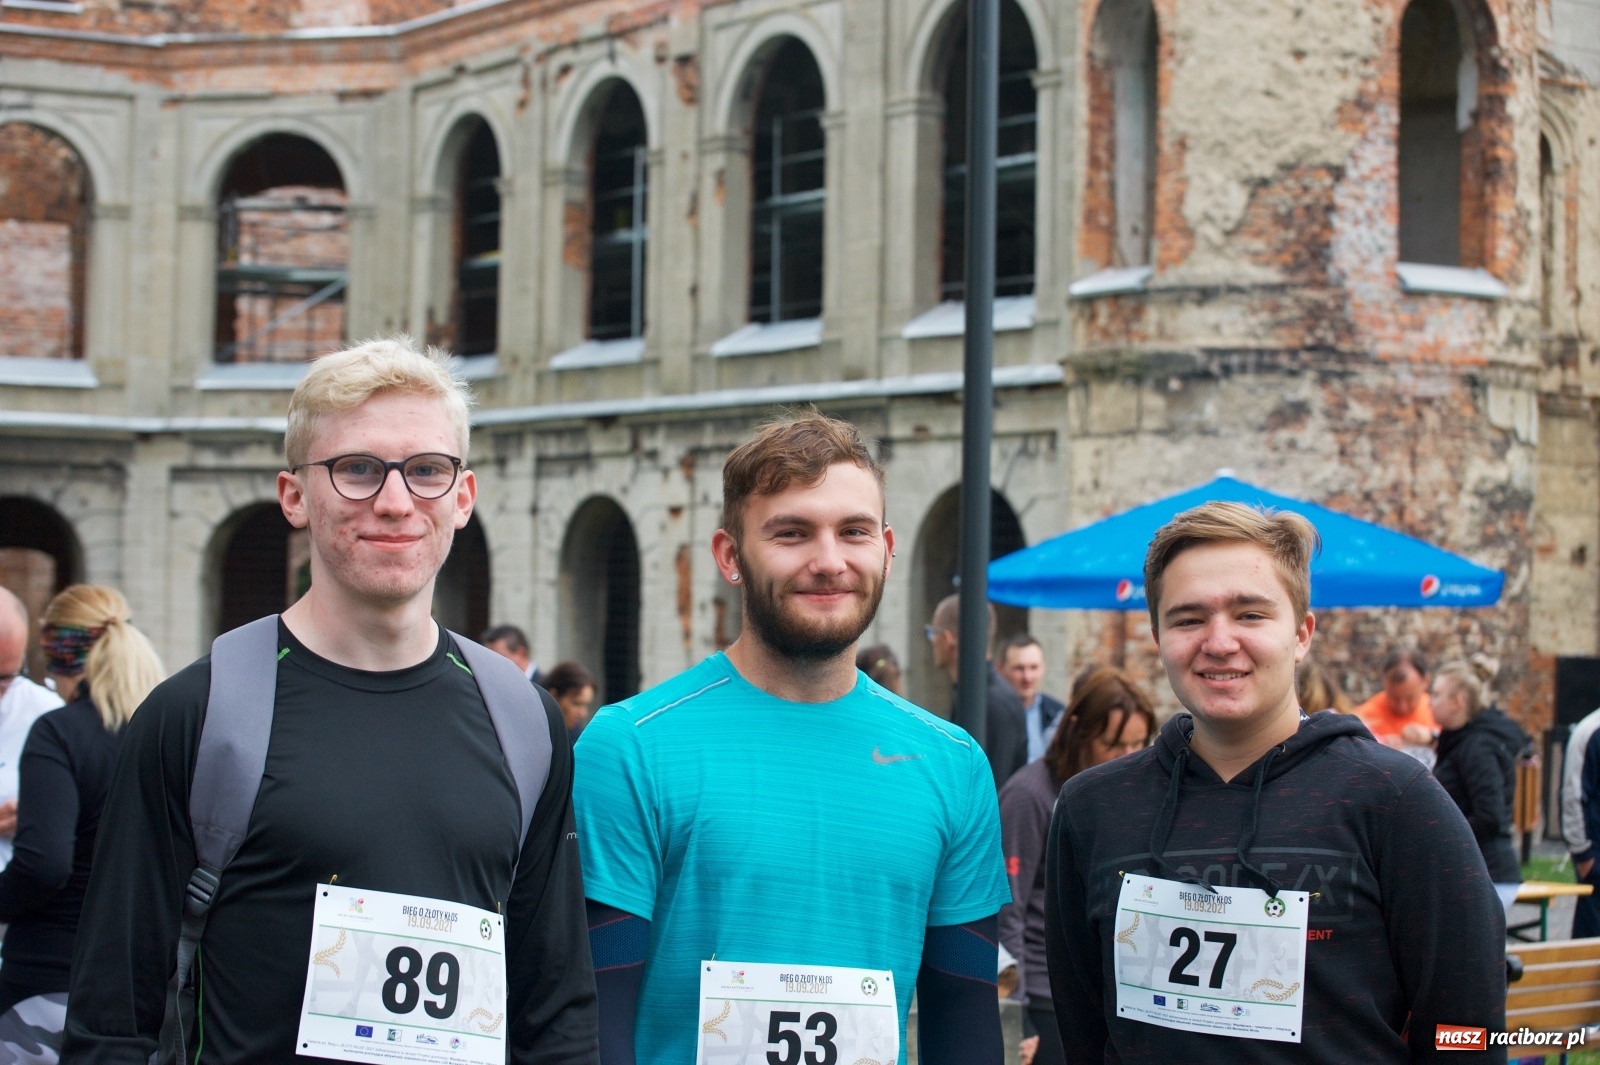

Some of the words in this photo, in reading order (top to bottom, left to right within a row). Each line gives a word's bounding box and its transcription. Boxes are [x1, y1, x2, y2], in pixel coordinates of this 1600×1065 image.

[1192, 892, 1197, 901] O
[418, 907, 424, 916] O
[1184, 901, 1226, 914] 19.09.2021
[407, 915, 453, 932] 19.09.2021
[1306, 929, 1334, 940] ENT
[1168, 926, 1237, 990] 27
[382, 946, 460, 1020] 89
[794, 974, 800, 983] O
[785, 982, 828, 994] 19.09.2021
[766, 1010, 838, 1065] 53
